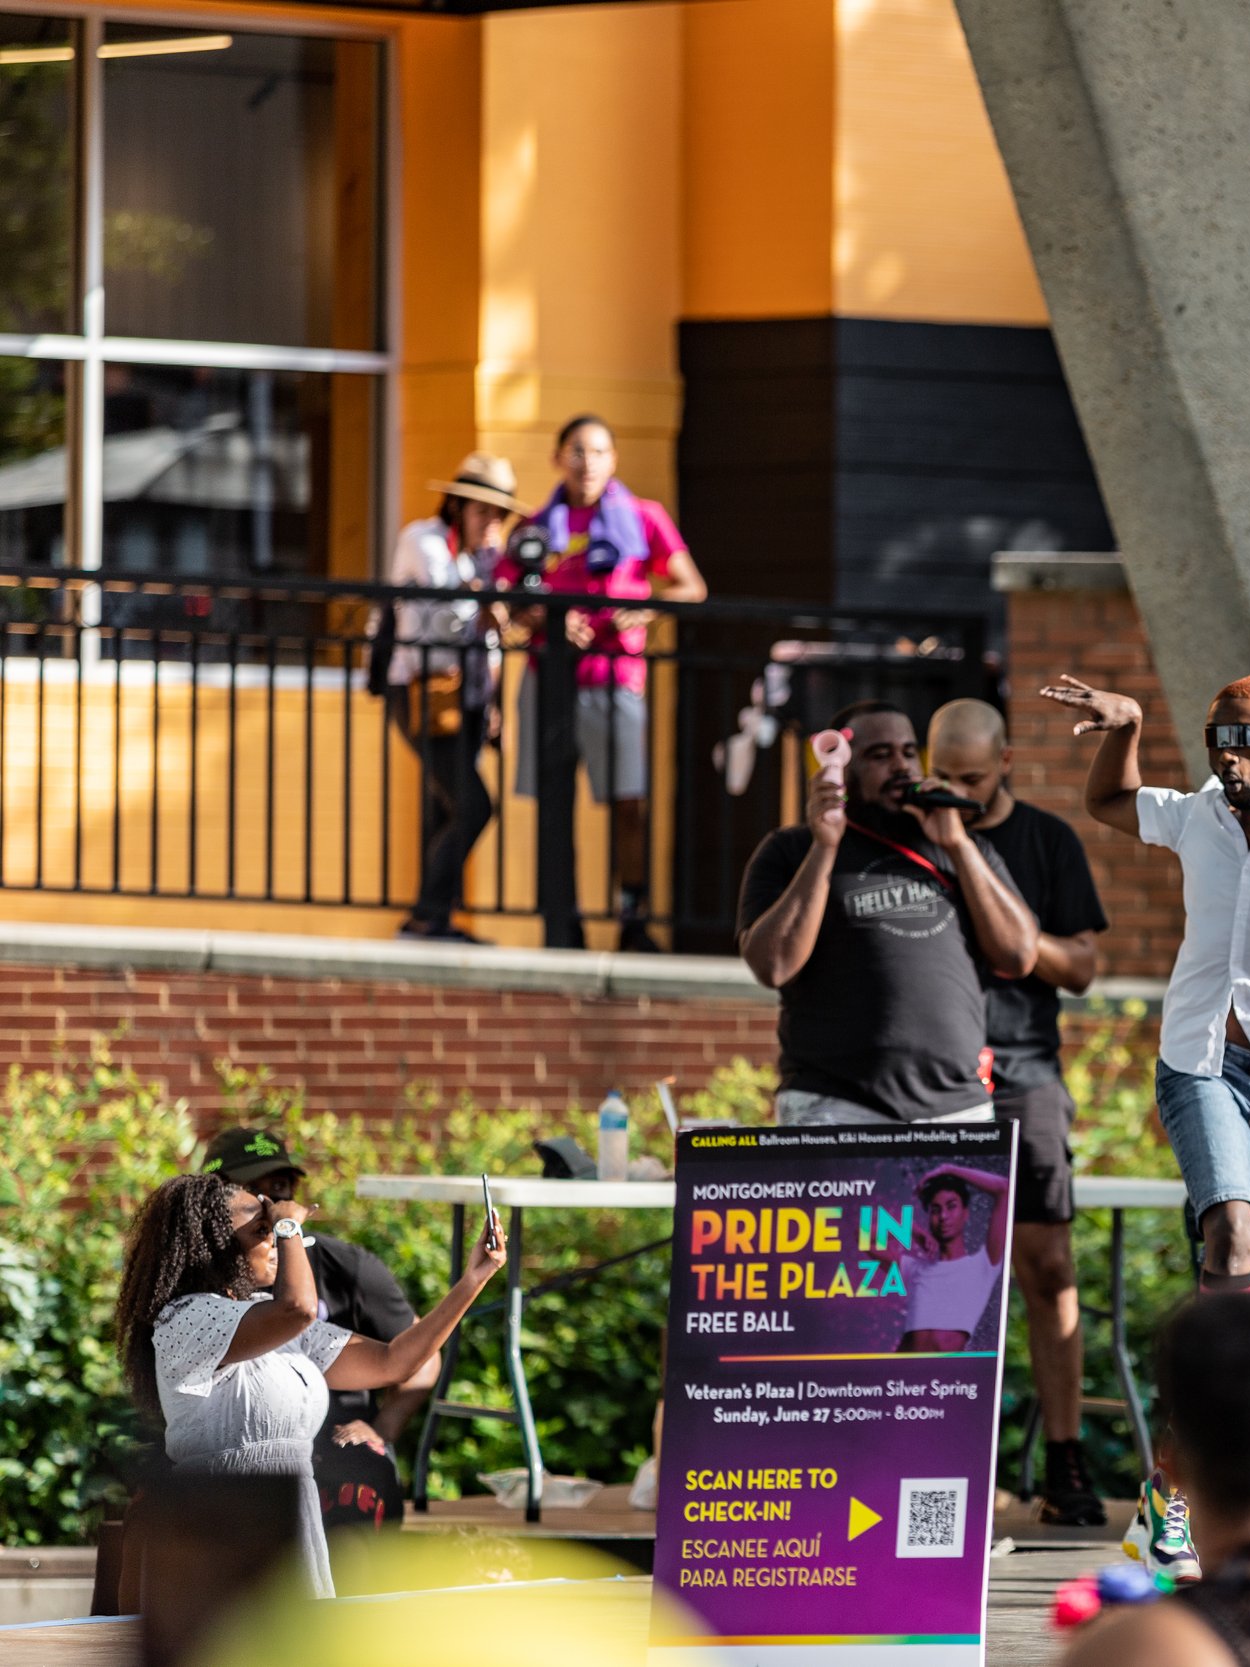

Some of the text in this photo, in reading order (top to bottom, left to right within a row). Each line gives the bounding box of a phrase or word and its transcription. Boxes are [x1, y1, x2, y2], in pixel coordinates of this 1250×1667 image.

[853, 886, 903, 917] HELLY
[691, 1129, 1000, 1148] CALLING ALL Ballroom Houses, Kiki Houses and Modeling Troupes!
[693, 1180, 875, 1200] MONTGOMERY COUNTY
[691, 1205, 914, 1255] PRIDE IN
[691, 1261, 907, 1300] THE PLAZA
[686, 1310, 795, 1333] FREE BALL
[755, 1382, 795, 1399] Plaza
[806, 1381, 883, 1398] Downtown
[886, 1379, 927, 1396] Silver
[929, 1379, 978, 1400] Spring
[713, 1405, 770, 1427] Sunday,
[773, 1405, 810, 1422] June
[812, 1407, 831, 1423] 27
[833, 1407, 883, 1423] 5:00PM
[893, 1404, 945, 1421] 8:00PM
[685, 1468, 839, 1491] SCAN HERE TO
[683, 1501, 792, 1522] CHECK-IN!
[681, 1532, 823, 1559] ESCANEE AQUÍ
[679, 1566, 858, 1587] PARA REGISTRARSE
